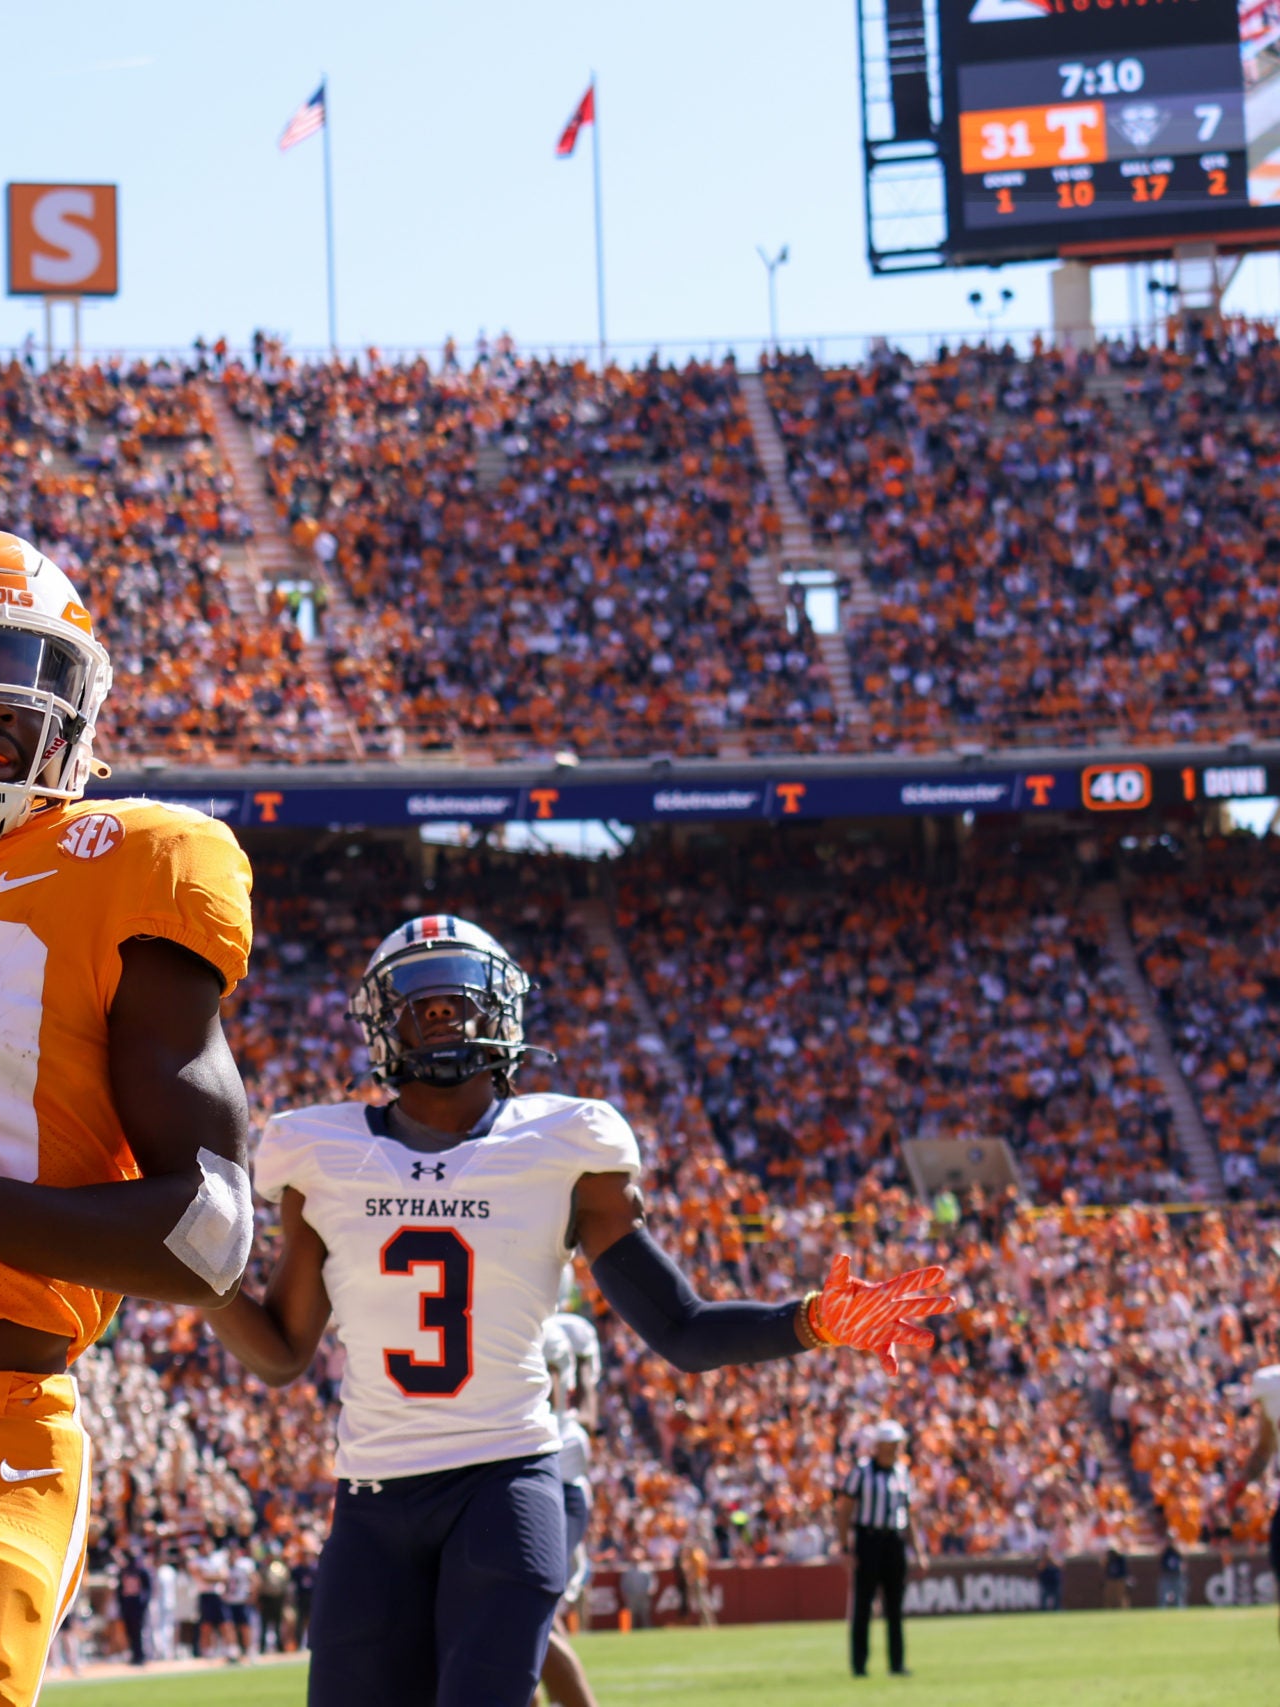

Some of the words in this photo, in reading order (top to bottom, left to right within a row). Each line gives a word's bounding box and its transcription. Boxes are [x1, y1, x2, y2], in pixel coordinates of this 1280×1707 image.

[1059, 58, 1144, 98] 7:10
[981, 121, 1035, 160] 31
[1046, 106, 1097, 160] T
[1194, 104, 1222, 142] 7
[1056, 181, 1095, 208] 10
[1131, 174, 1169, 202] 17
[1207, 169, 1228, 196] 2
[996, 187, 1015, 214] 1
[1090, 769, 1145, 803] 40
[1203, 766, 1267, 797] DOWN
[61, 814, 119, 859] SEC
[365, 1198, 491, 1219] SKYHAWKS
[379, 1224, 475, 1399] 3
[902, 1575, 960, 1614] APA
